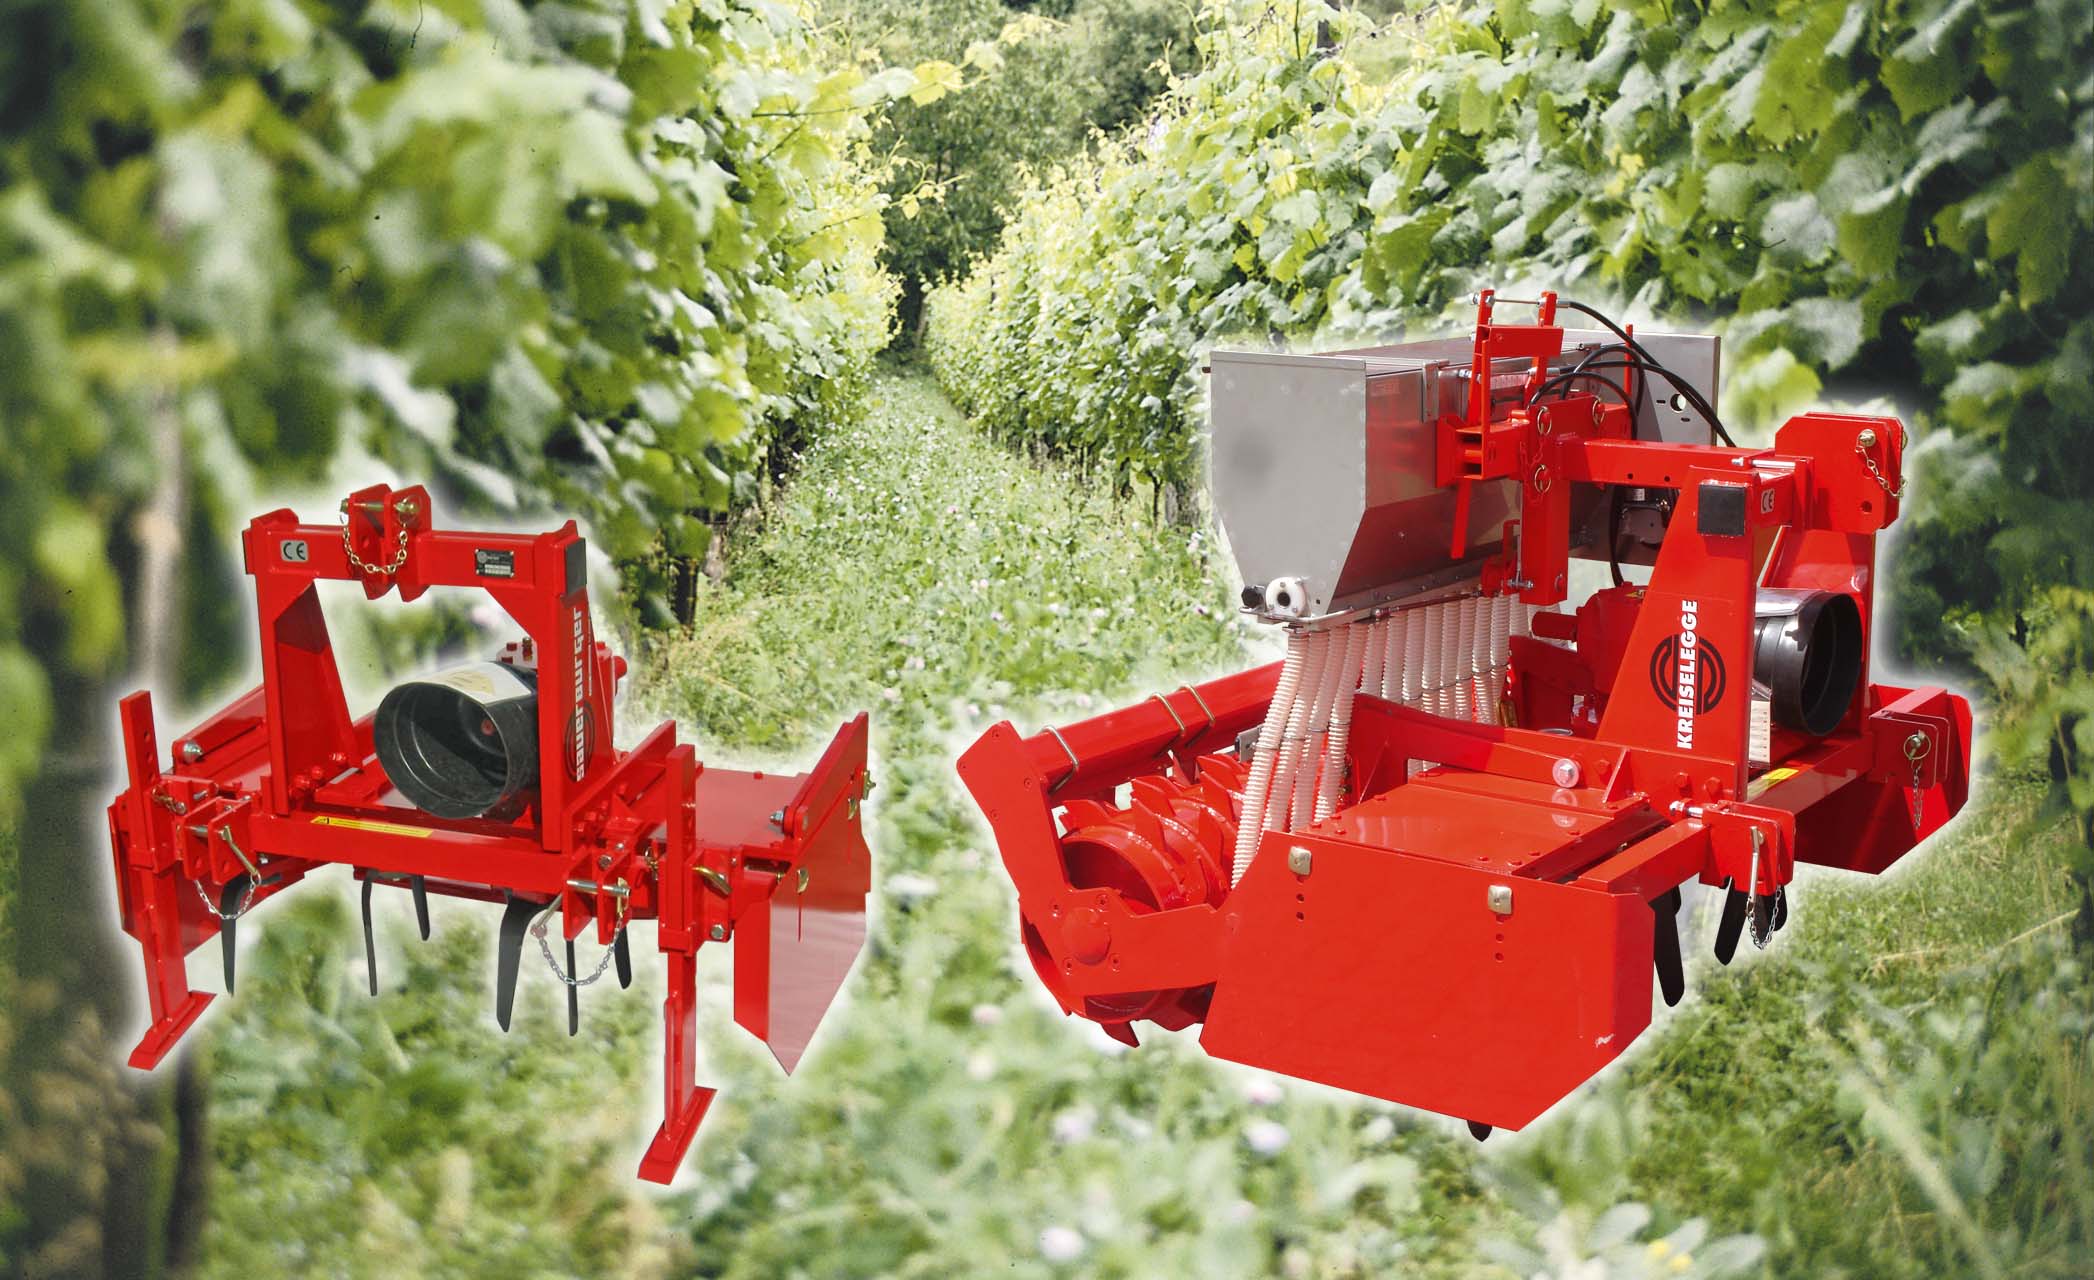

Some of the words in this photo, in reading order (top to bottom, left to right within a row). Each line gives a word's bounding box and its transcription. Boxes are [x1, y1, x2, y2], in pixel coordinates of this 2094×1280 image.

[1762, 490, 1774, 511] CE
[283, 542, 306, 560] CE
[1676, 599, 1698, 750] KREISELEGGE
